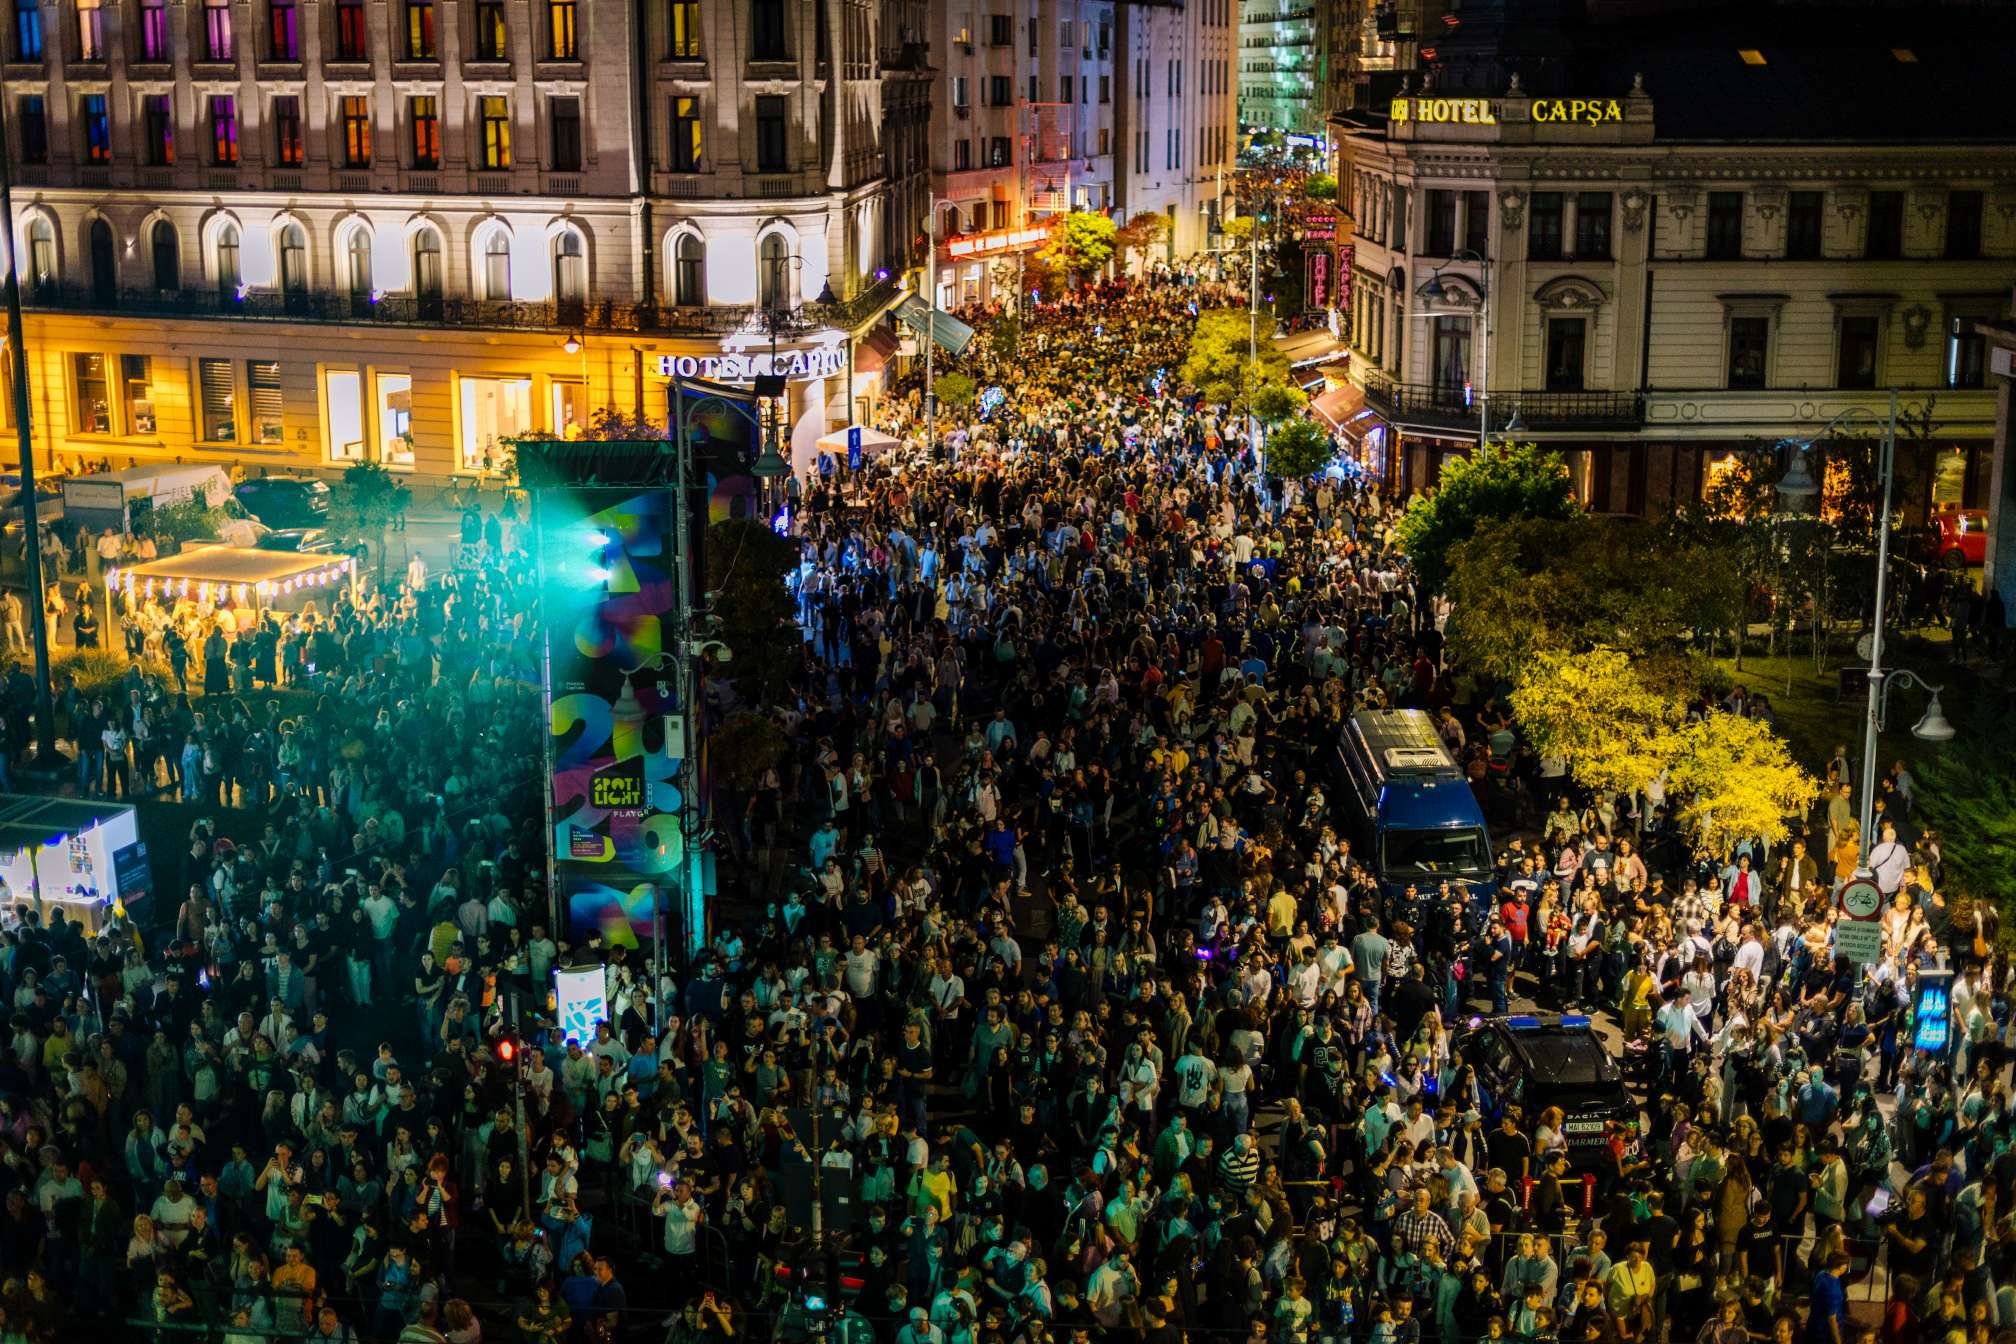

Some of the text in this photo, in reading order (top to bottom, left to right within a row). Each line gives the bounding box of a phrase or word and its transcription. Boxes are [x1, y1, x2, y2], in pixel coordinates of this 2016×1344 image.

[1418, 99, 1496, 125] HOTEL
[1314, 255, 1327, 308] HOTEL
[658, 355, 756, 377] HOTEL
[594, 777, 633, 792] SPOT
[594, 791, 641, 805] LIGHT
